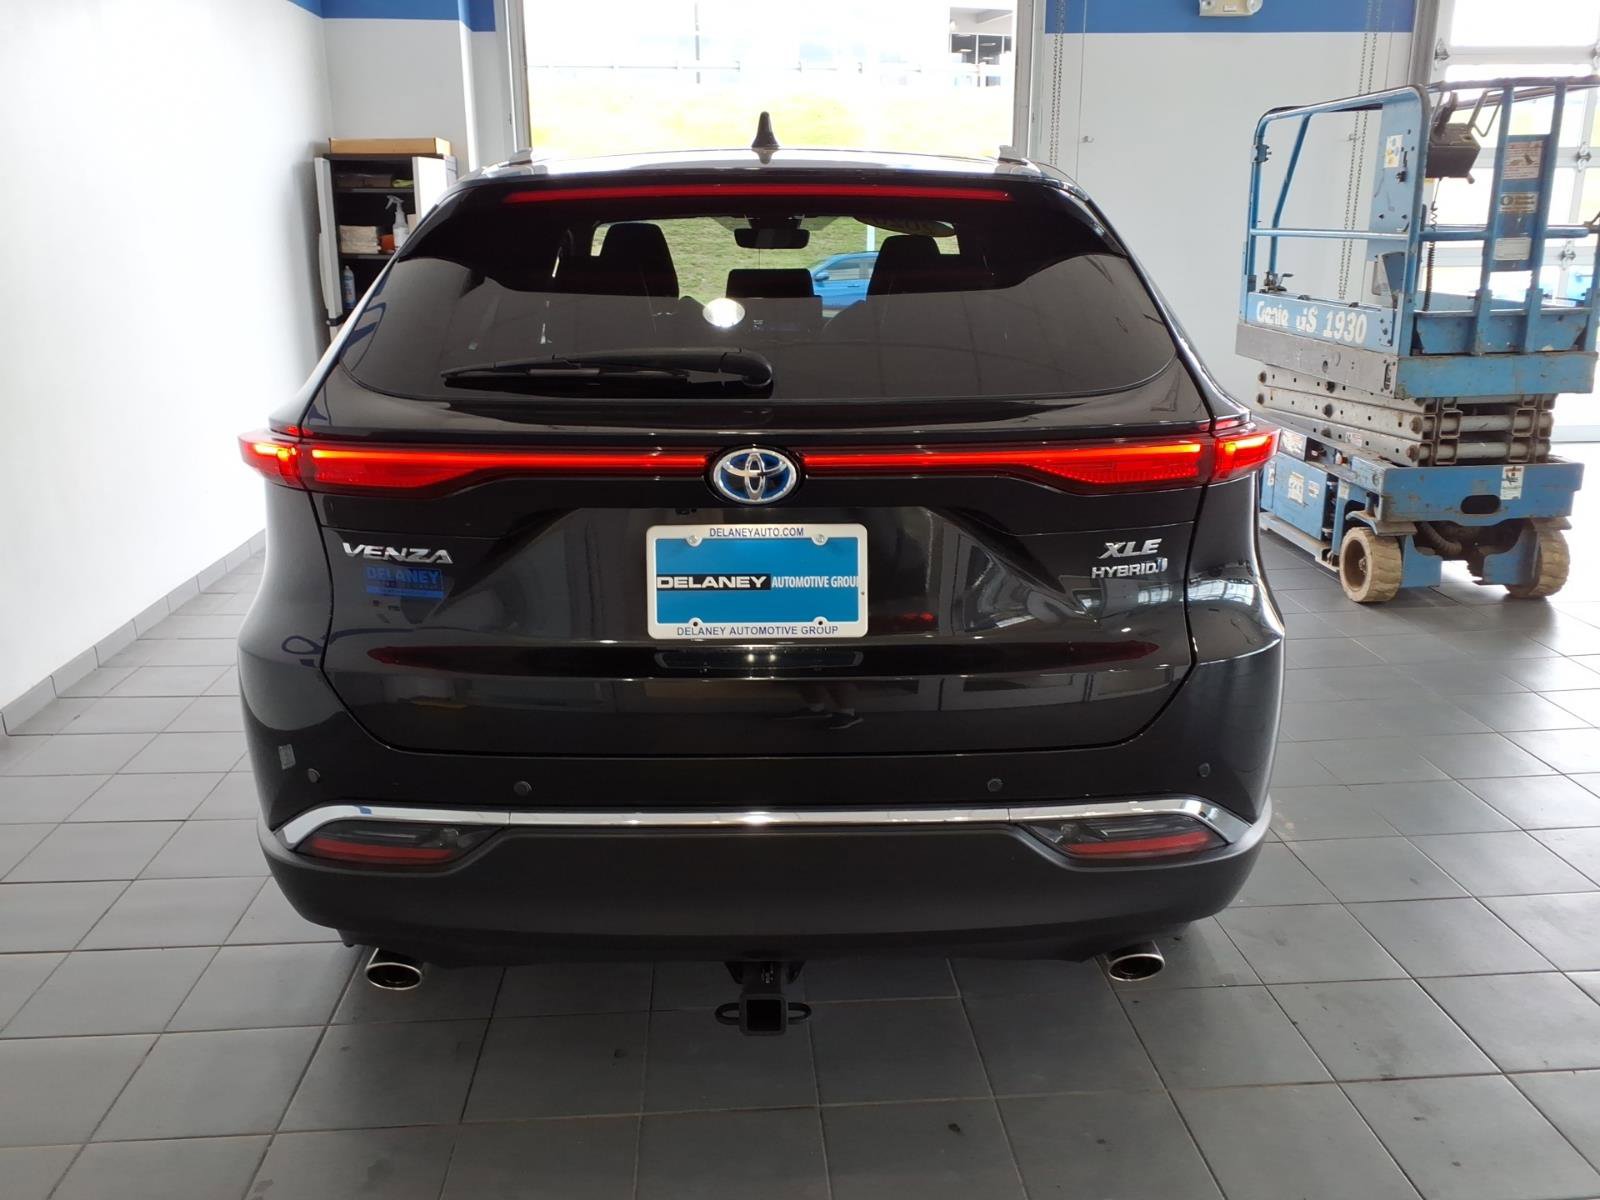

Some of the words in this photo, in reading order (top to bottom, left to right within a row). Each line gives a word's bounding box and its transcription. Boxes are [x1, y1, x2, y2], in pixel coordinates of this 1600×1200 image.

[1322, 309, 1368, 344] 1930
[709, 527, 804, 538] DELANEYAUTO.COM
[342, 541, 454, 565] VENZA
[1097, 538, 1162, 559] XLE
[1091, 562, 1157, 579] HYBRID
[656, 576, 767, 589] DELANEY
[771, 575, 829, 588] AUTOMOTIVE
[677, 626, 726, 636] DELANEY
[729, 625, 798, 636] AUTOMOTIVE
[801, 625, 839, 635] GROUP
